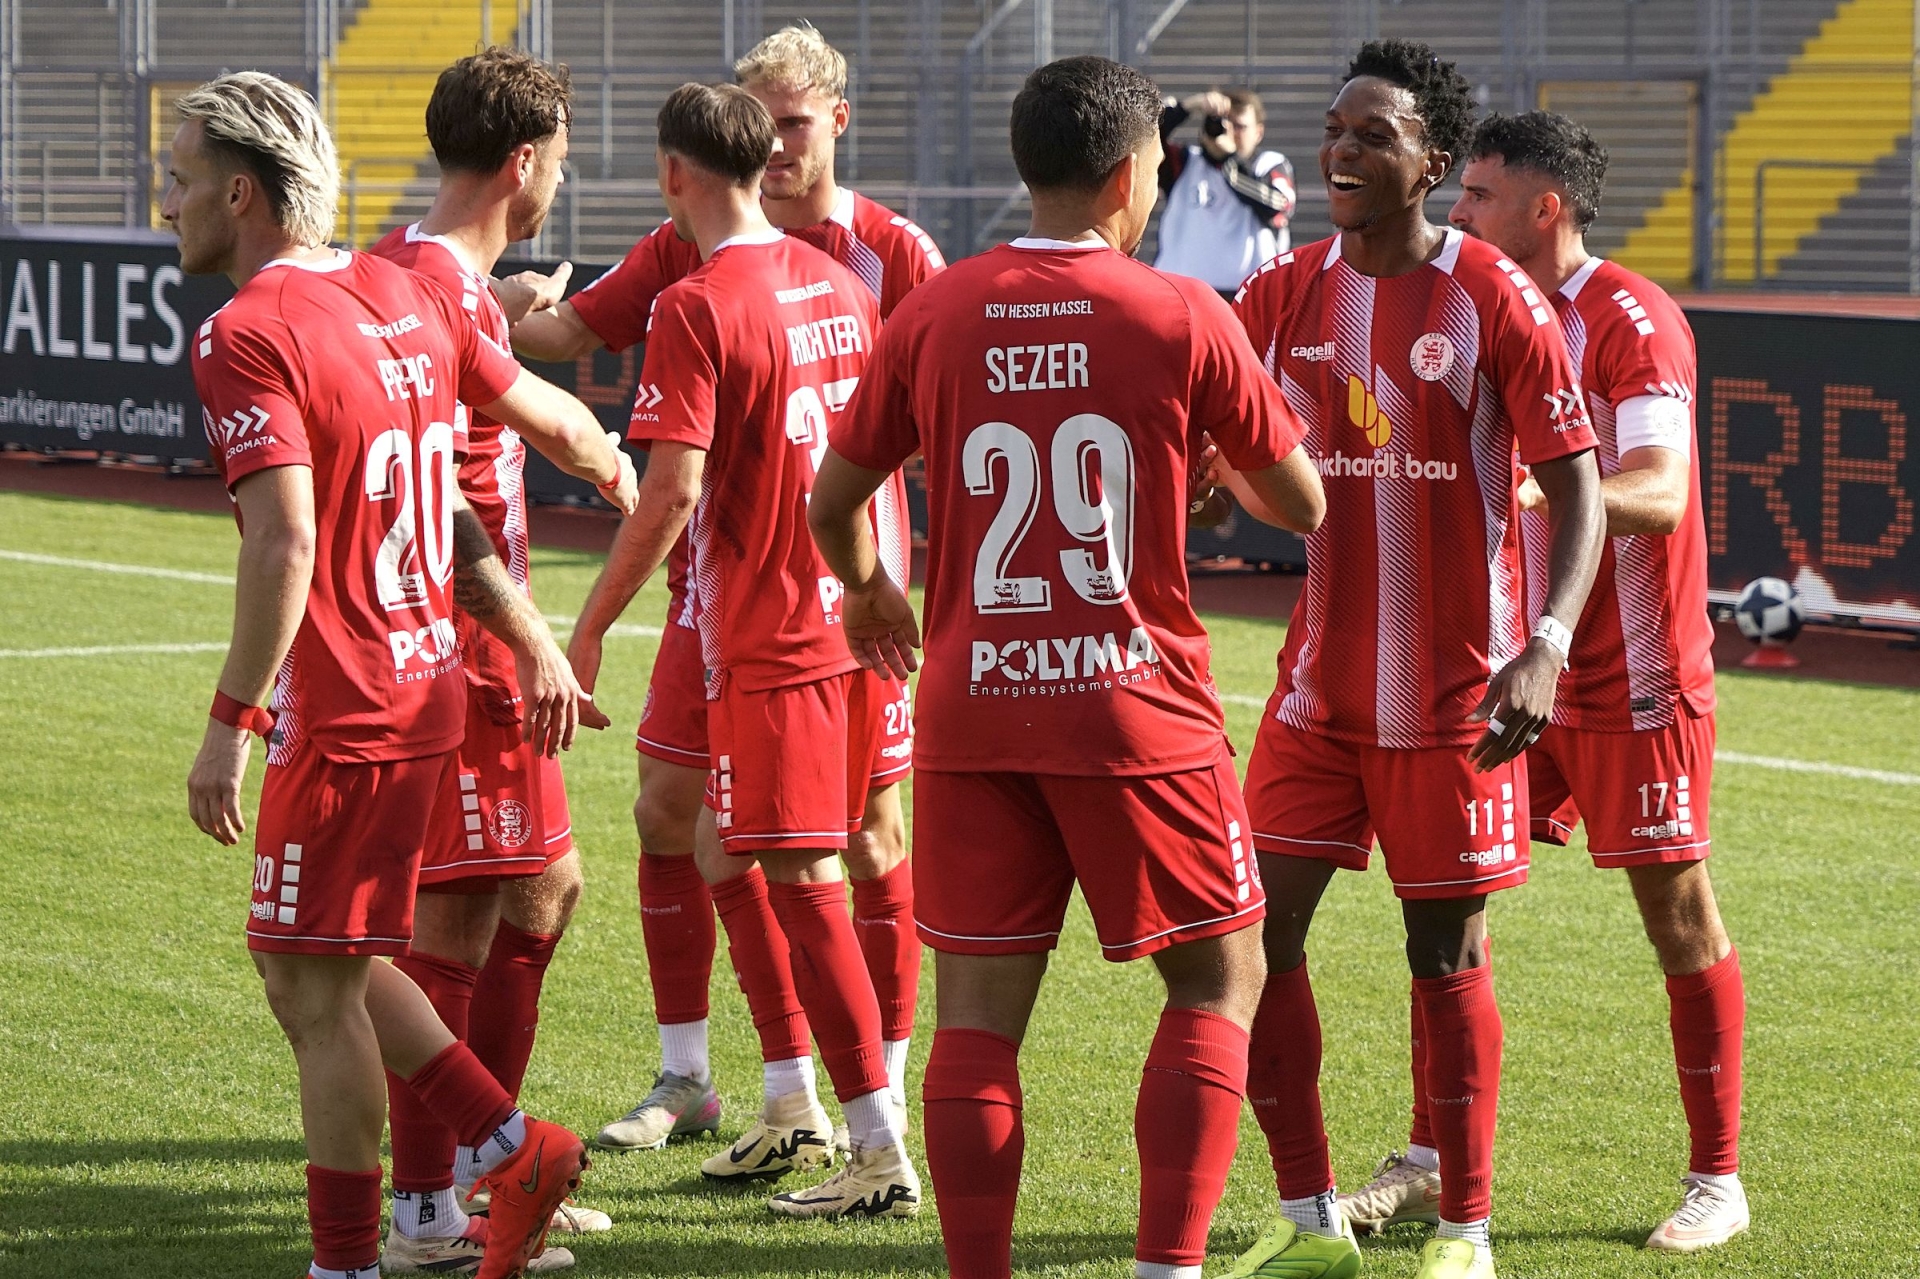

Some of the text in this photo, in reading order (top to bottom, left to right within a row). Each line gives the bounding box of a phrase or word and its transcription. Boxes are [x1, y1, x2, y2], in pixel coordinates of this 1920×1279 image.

[4, 258, 185, 366] ALLES
[985, 300, 1094, 318] KSV HESSEN KASSEL
[787, 314, 862, 366] RICHTER
[1291, 341, 1335, 360] capelli
[985, 342, 1090, 393] SEZER
[118, 397, 186, 439] GmbH
[1405, 453, 1457, 480] bau
[365, 422, 454, 612] 20
[962, 413, 1136, 614] 29
[971, 626, 1160, 682] POLYMA
[970, 664, 1162, 697] Energiesysteme GmbH
[884, 699, 906, 736] 27
[1466, 799, 1493, 836] 11
[1638, 781, 1668, 817] 17
[1631, 820, 1677, 838] capelli
[1459, 844, 1502, 866] capelli
[754, 1129, 827, 1168] AIR
[842, 1184, 917, 1216] AIR
